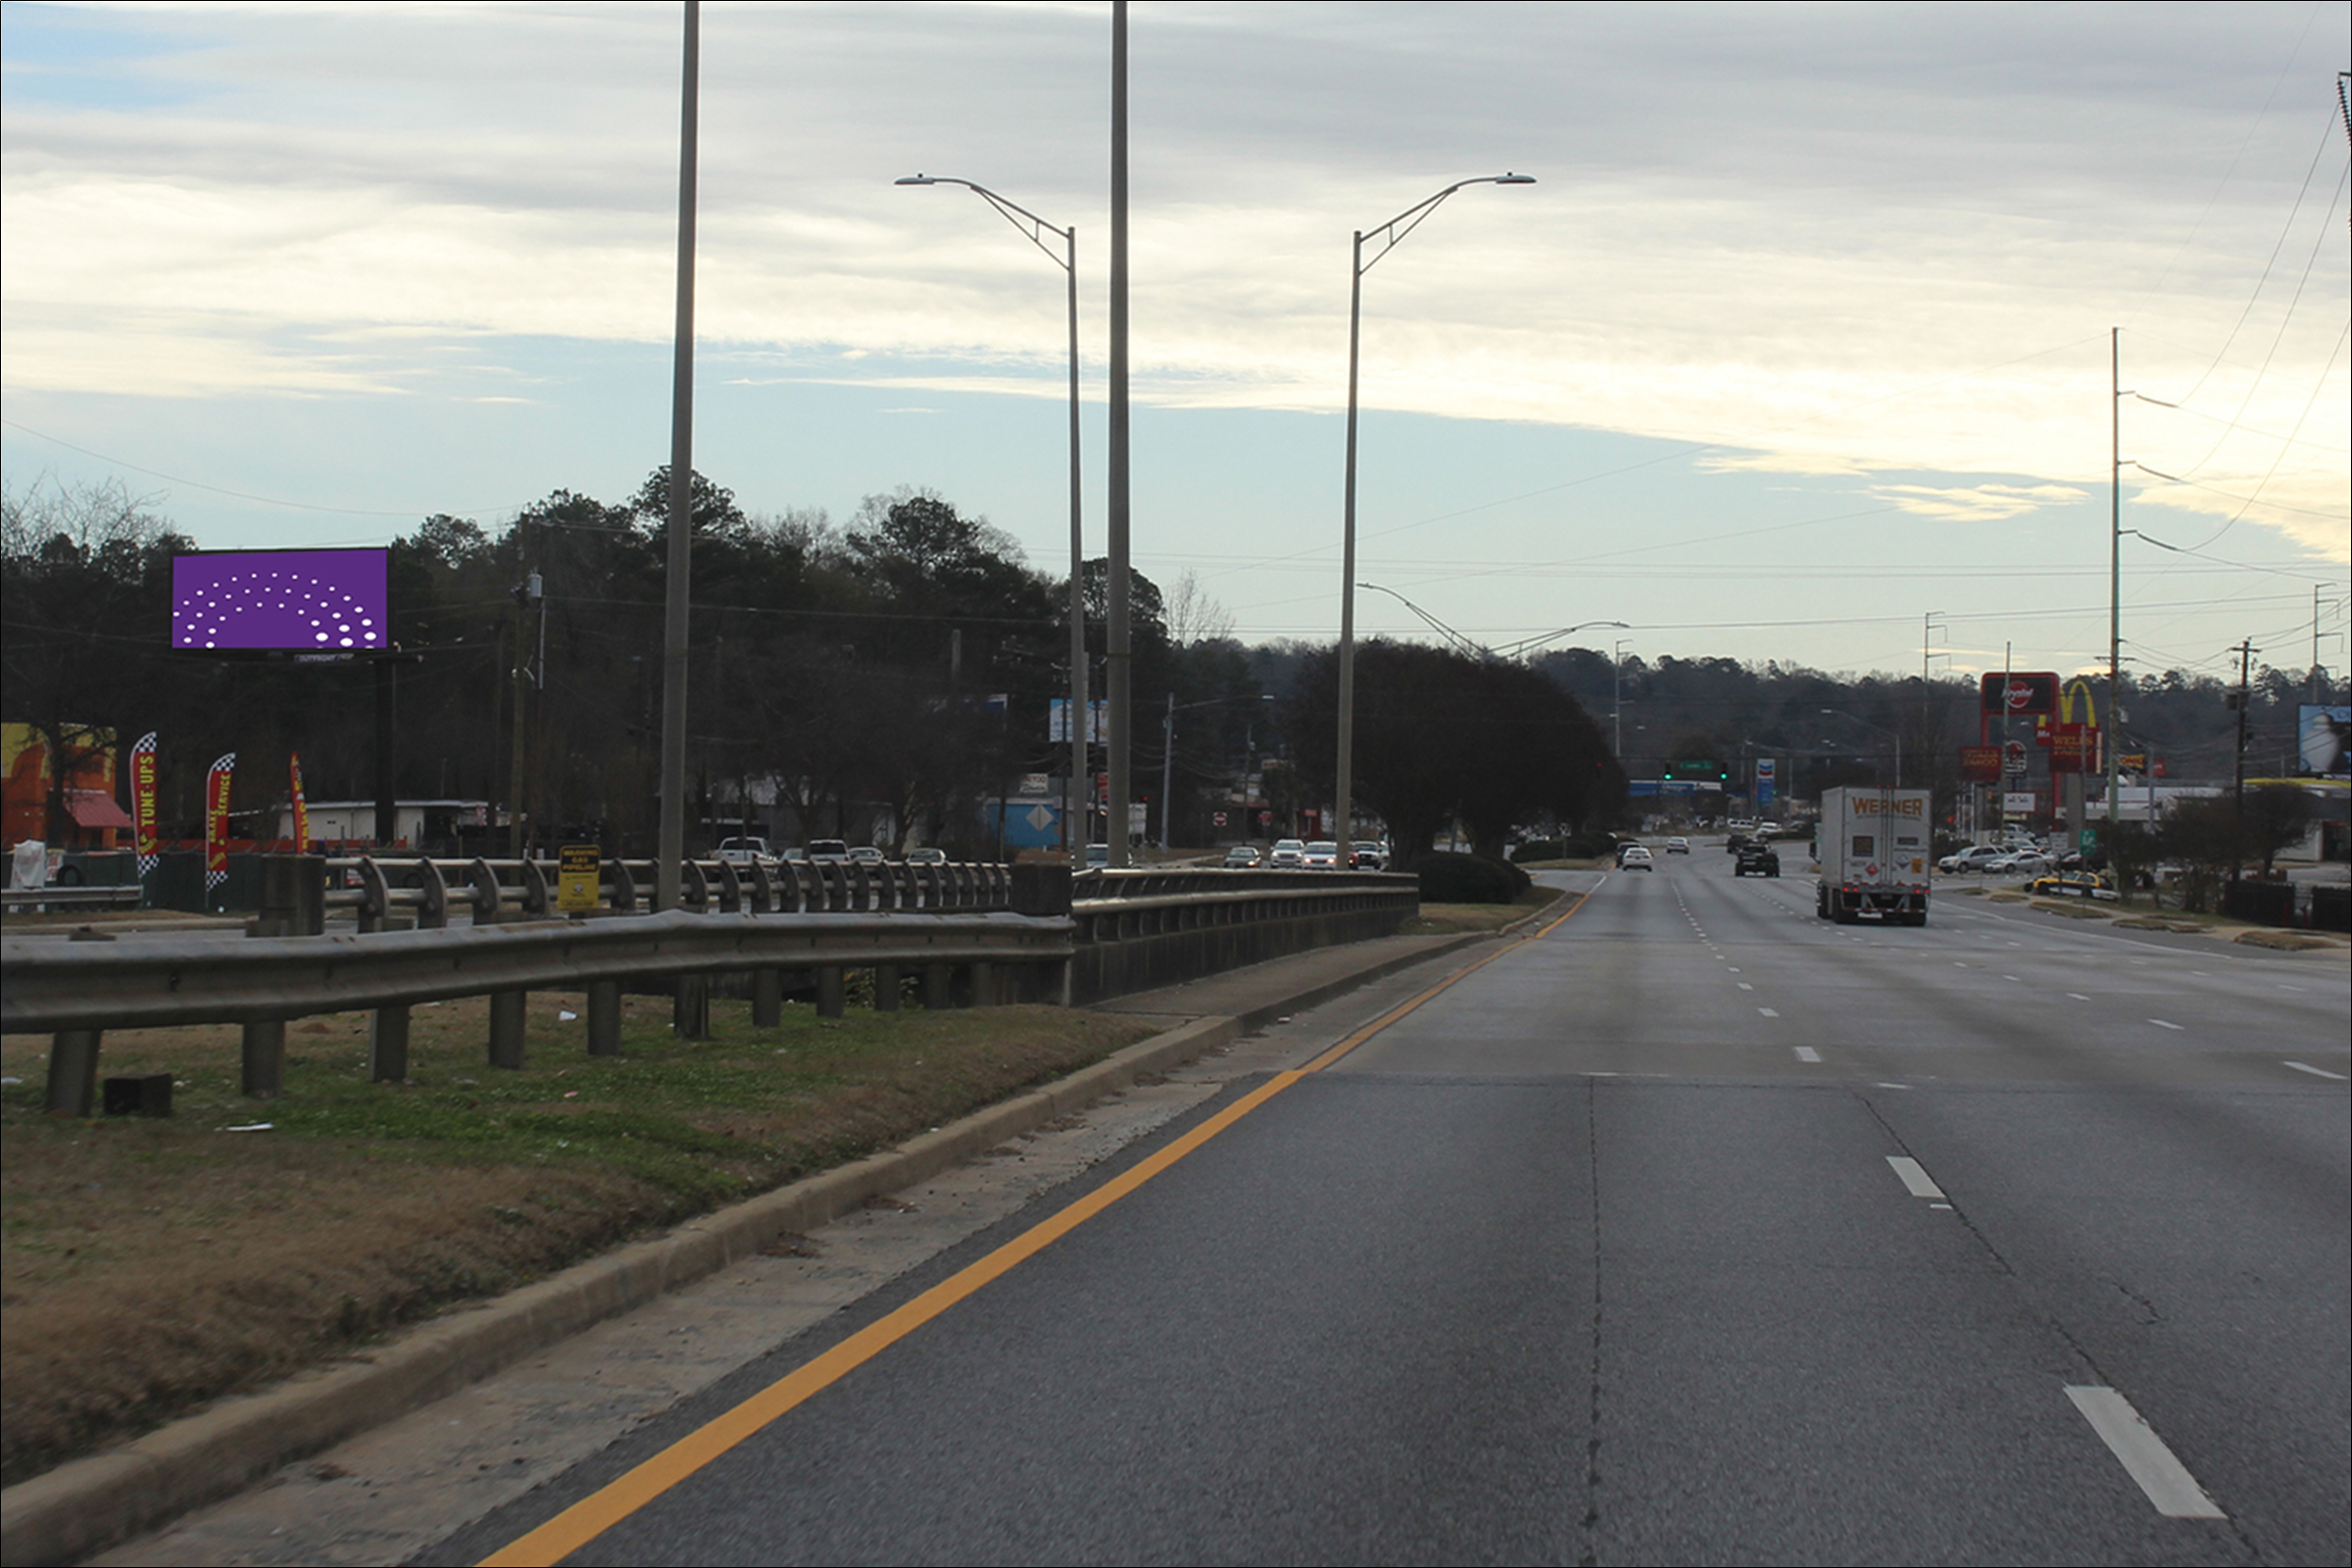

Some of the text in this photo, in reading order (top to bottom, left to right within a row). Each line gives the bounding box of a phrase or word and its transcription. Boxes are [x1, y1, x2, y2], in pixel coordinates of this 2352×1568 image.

[139, 755, 156, 827] TUNE-UPS
[217, 773, 232, 816] SERVICE
[1852, 797, 1923, 816] WERNER
